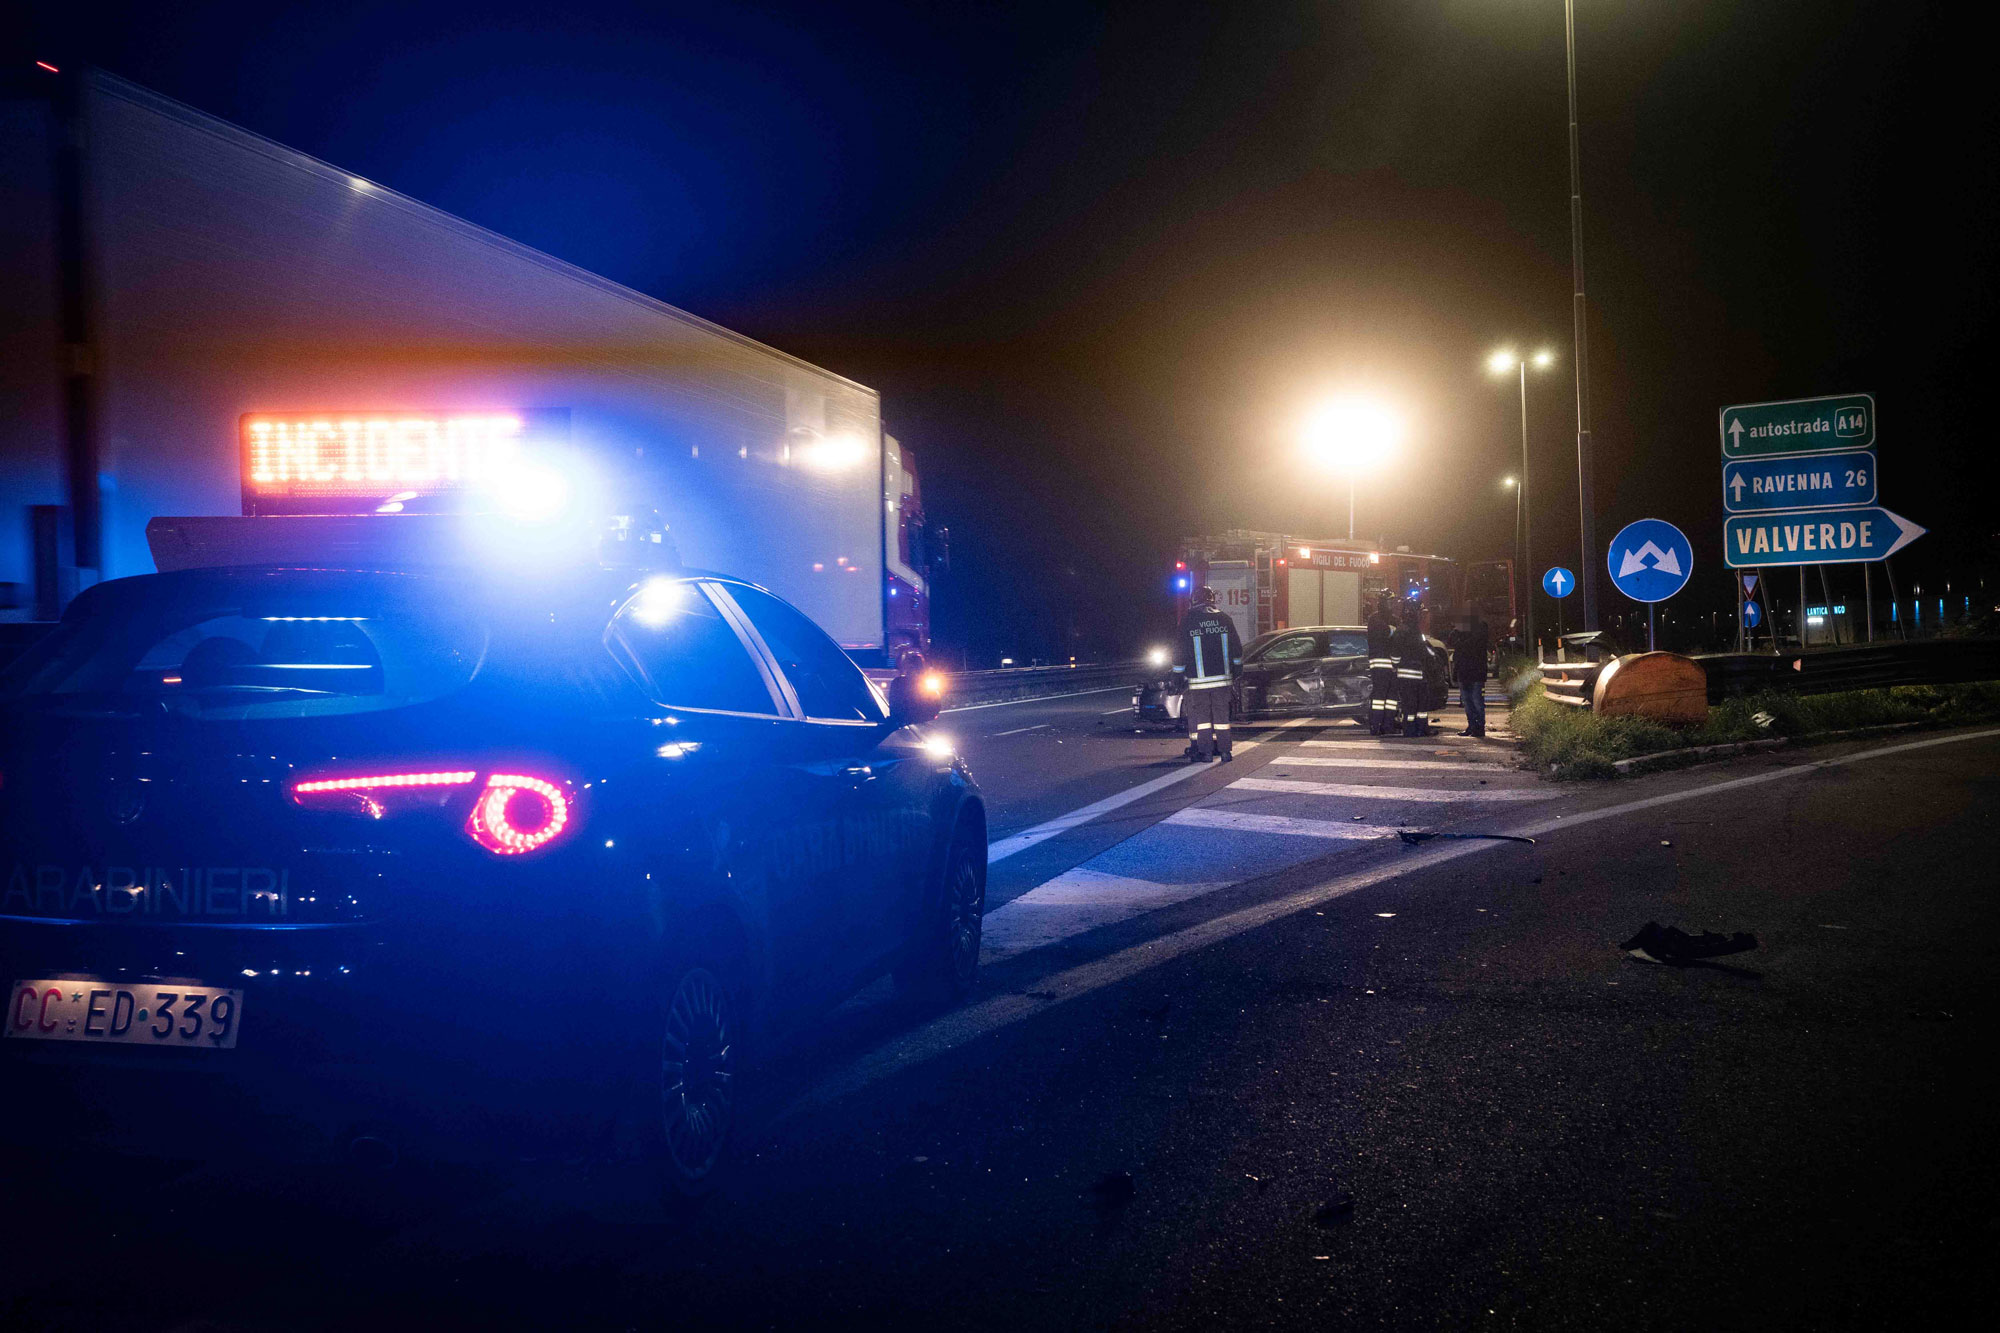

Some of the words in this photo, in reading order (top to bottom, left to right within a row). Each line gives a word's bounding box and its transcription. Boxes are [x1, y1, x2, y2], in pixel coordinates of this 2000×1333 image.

[1750, 418, 1830, 438] autostrada
[1838, 414, 1863, 430] A14
[1753, 472, 1833, 494] RAVENNA
[1845, 470, 1867, 488] 26
[1736, 521, 1873, 554] VALVERDE
[1312, 554, 1330, 566] VIGILI
[1334, 557, 1346, 567] DEL
[1349, 557, 1370, 568] FUOCO
[1227, 588, 1250, 606] 115
[1190, 629, 1204, 637] DEL
[1199, 620, 1219, 628] VIGILI
